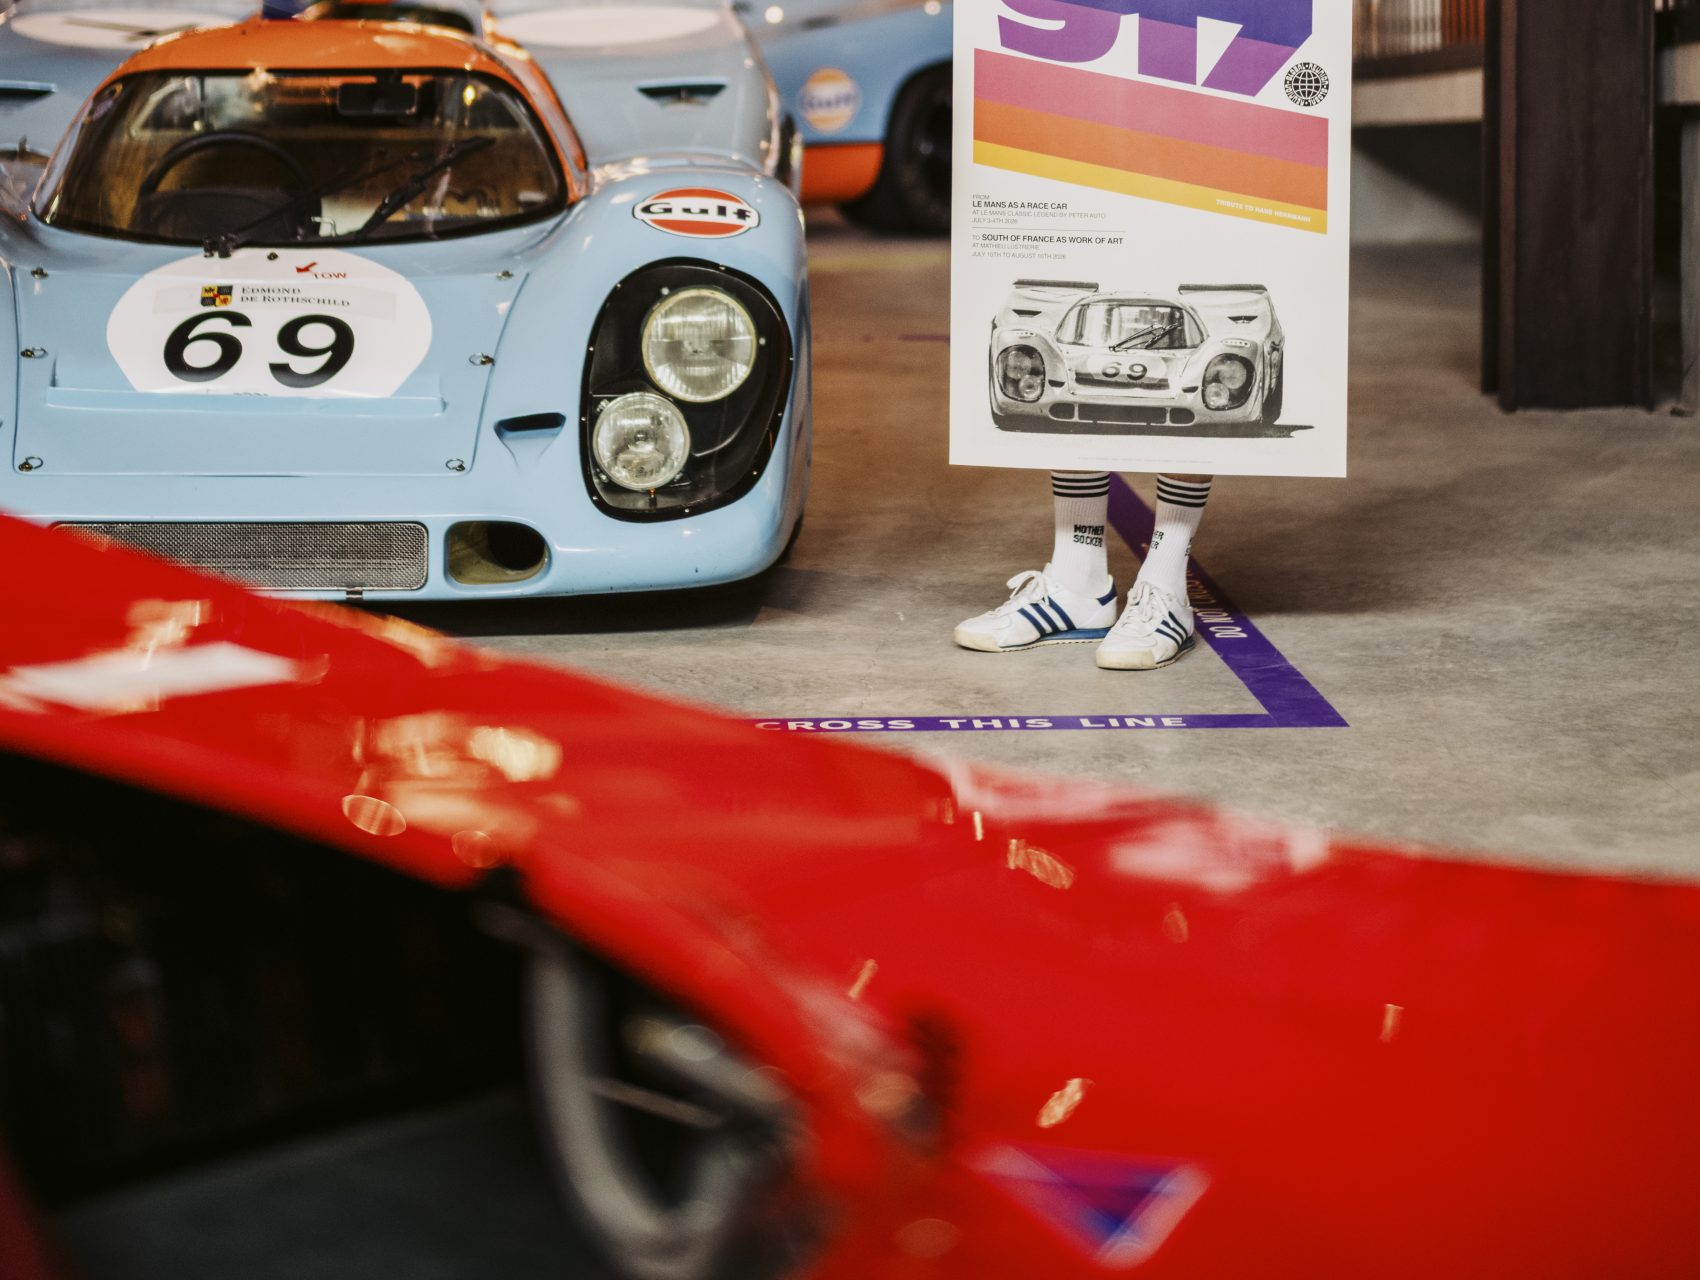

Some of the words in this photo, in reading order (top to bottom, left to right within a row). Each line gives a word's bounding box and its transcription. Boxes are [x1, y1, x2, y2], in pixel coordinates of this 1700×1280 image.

[641, 202, 752, 221] Gulf
[1027, 202, 1049, 210] RACE
[1010, 234, 1021, 242] OF
[1022, 235, 1054, 243] FRANCE
[263, 296, 350, 306] ROTHSCHILD
[163, 310, 355, 389] 69
[1102, 362, 1148, 380] 69
[1074, 524, 1104, 535] MOTHER
[1209, 626, 1248, 638] DO
[754, 720, 915, 731] CROSS
[939, 718, 1054, 730] THIS
[1079, 717, 1188, 728] LINE
